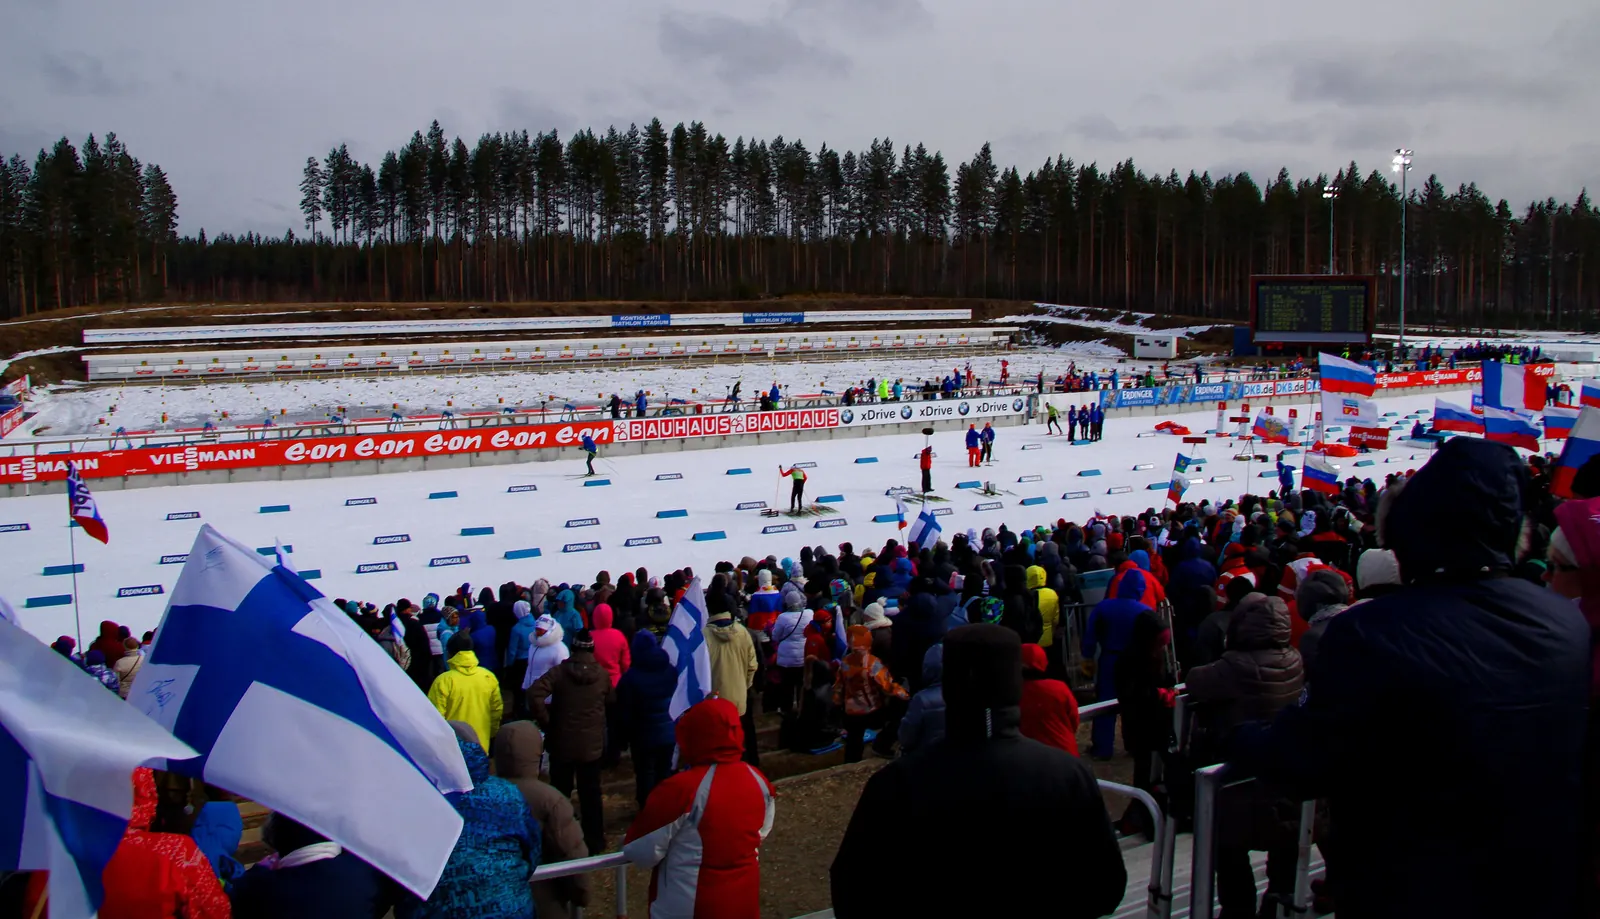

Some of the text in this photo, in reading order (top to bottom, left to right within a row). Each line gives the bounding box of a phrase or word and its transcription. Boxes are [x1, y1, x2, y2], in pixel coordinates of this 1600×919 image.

[1194, 385, 1224, 395] ERDINGER
[1244, 383, 1273, 396] DKB.de
[1276, 381, 1304, 394] DKB.de
[1122, 389, 1154, 400] ERDINGER
[920, 405, 953, 417] xDrive
[976, 402, 1008, 413] xDrive
[861, 408, 896, 421] xDrive
[746, 409, 838, 432] BAUHAUS
[630, 416, 730, 440] BAUHAUS
[150, 447, 255, 470] VIESSMANN
[569, 519, 592, 527] ERDINGER
[766, 525, 789, 533] ERDINGER
[567, 543, 592, 551] ERDINGER
[433, 557, 461, 565] ERDINGER
[360, 564, 388, 572] ERDINGER
[121, 586, 152, 596] ERDINGER
